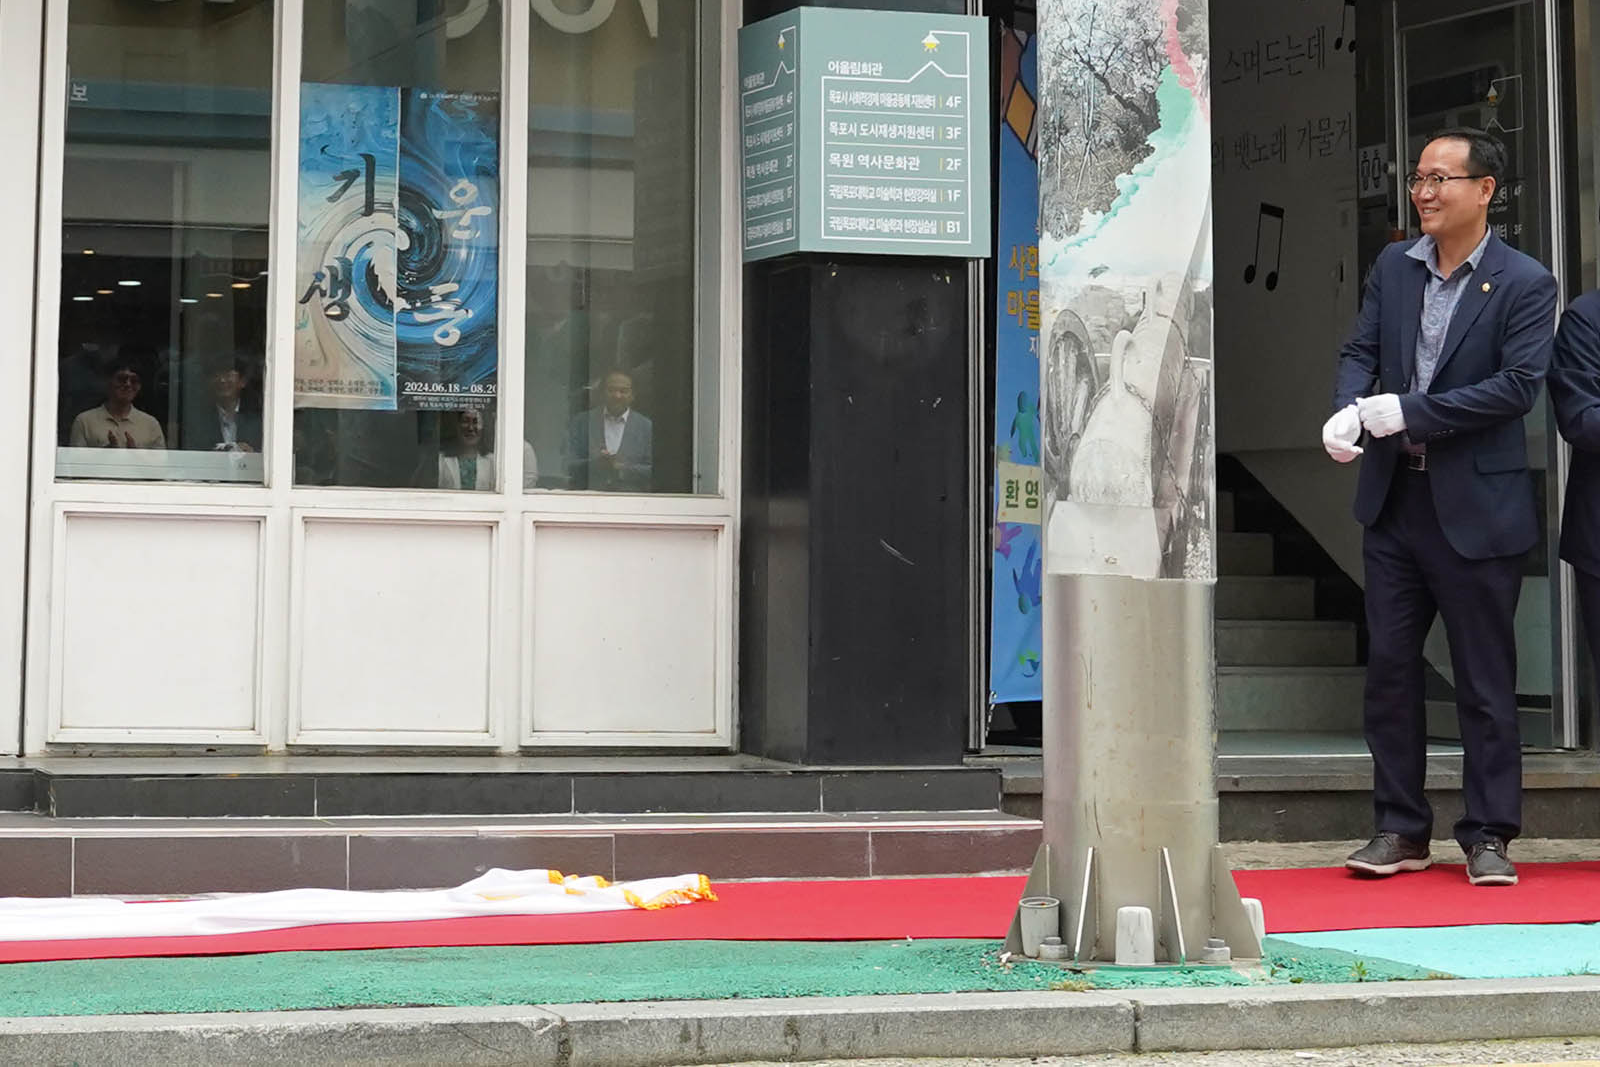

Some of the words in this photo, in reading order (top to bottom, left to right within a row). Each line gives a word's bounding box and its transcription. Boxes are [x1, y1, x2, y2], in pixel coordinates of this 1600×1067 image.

[1221, 26, 1326, 84] 스며드는데
[827, 61, 884, 77] 어울림회관
[828, 90, 849, 105] 목포시
[849, 91, 879, 107] 사회적경제
[879, 92, 911, 108] 마을공동체
[912, 94, 936, 109] 지원센터
[946, 96, 962, 109] 4F
[828, 121, 857, 137] 목포시
[859, 123, 935, 141] 도시재생지원센터
[946, 127, 962, 140] 3F
[1233, 124, 1287, 170] 뱃노래
[828, 153, 854, 168] 목원
[857, 154, 921, 171] 역사문화관
[946, 158, 962, 170] 2F
[829, 184, 875, 201] 국립목포대학교
[947, 190, 961, 202] 1F
[829, 216, 875, 232] 국립목포대학교
[946, 221, 961, 233] B1
[404, 381, 460, 393] 2024.06.18
